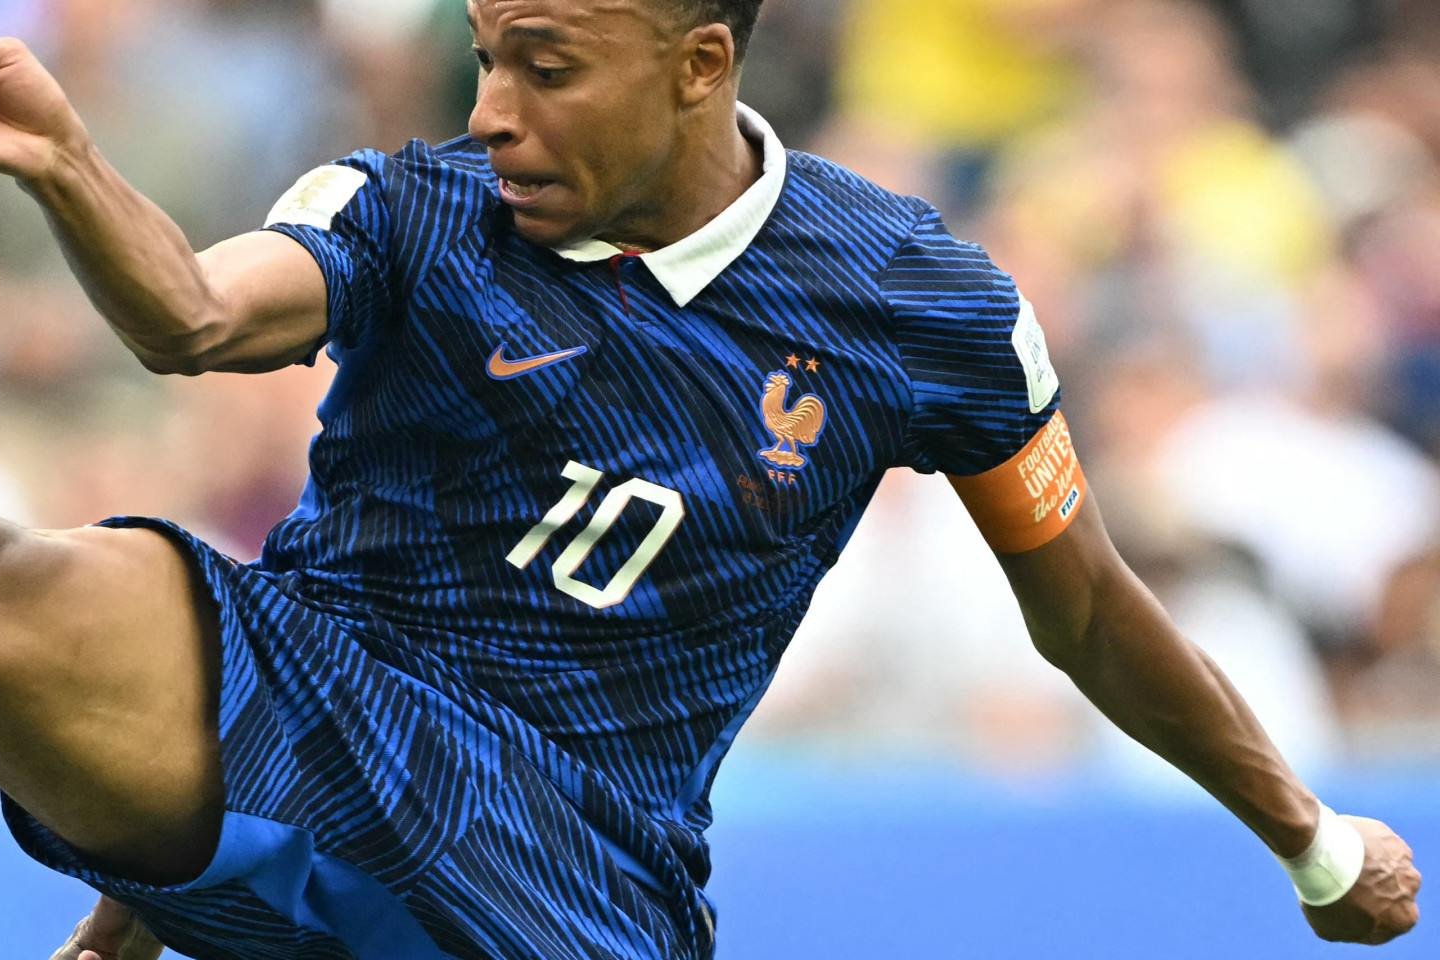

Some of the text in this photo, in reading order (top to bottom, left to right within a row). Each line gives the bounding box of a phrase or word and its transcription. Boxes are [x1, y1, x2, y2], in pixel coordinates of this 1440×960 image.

[767, 468, 797, 485] FFF
[1060, 489, 1079, 517] FIFA
[504, 459, 686, 609] 10
